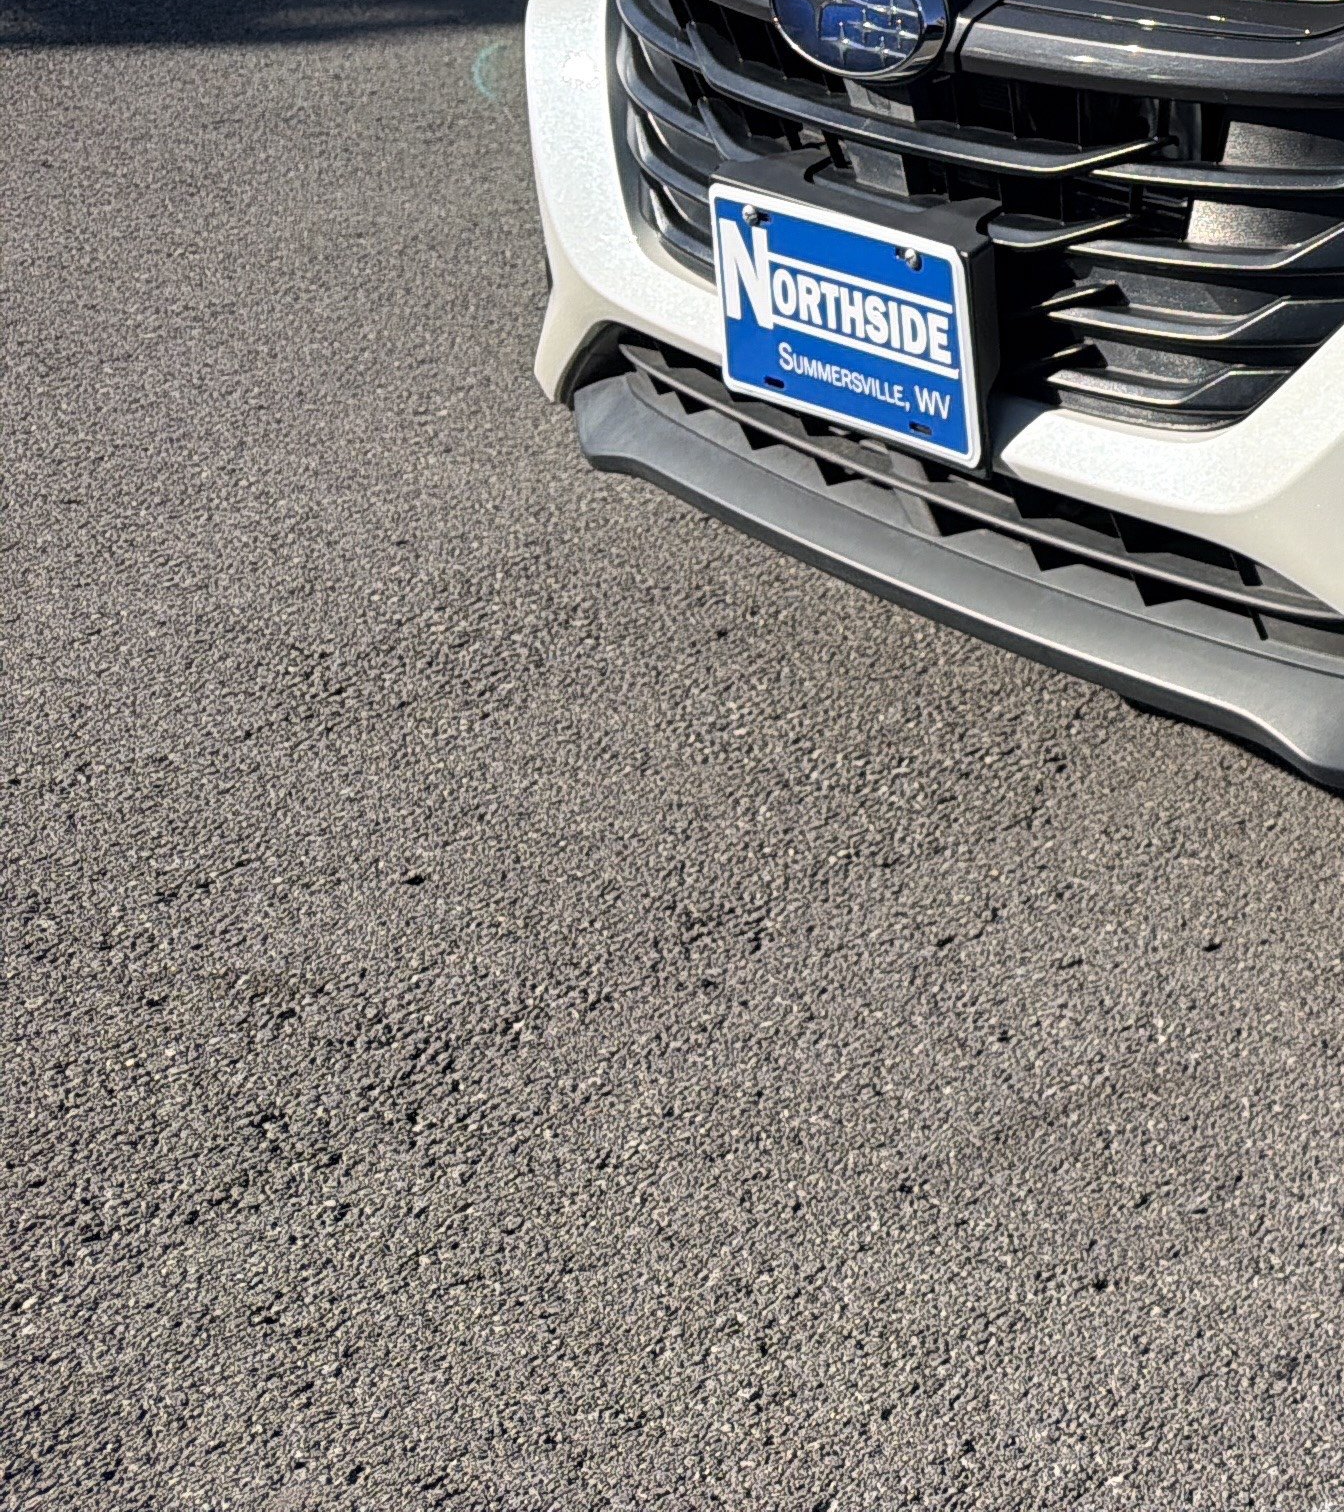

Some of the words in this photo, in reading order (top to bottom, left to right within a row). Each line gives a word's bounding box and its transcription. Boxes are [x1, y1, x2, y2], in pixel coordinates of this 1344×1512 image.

[719, 217, 953, 364] NORTHSIDE
[778, 342, 910, 412] SUMMERSVILLE,
[915, 385, 951, 420] WV
